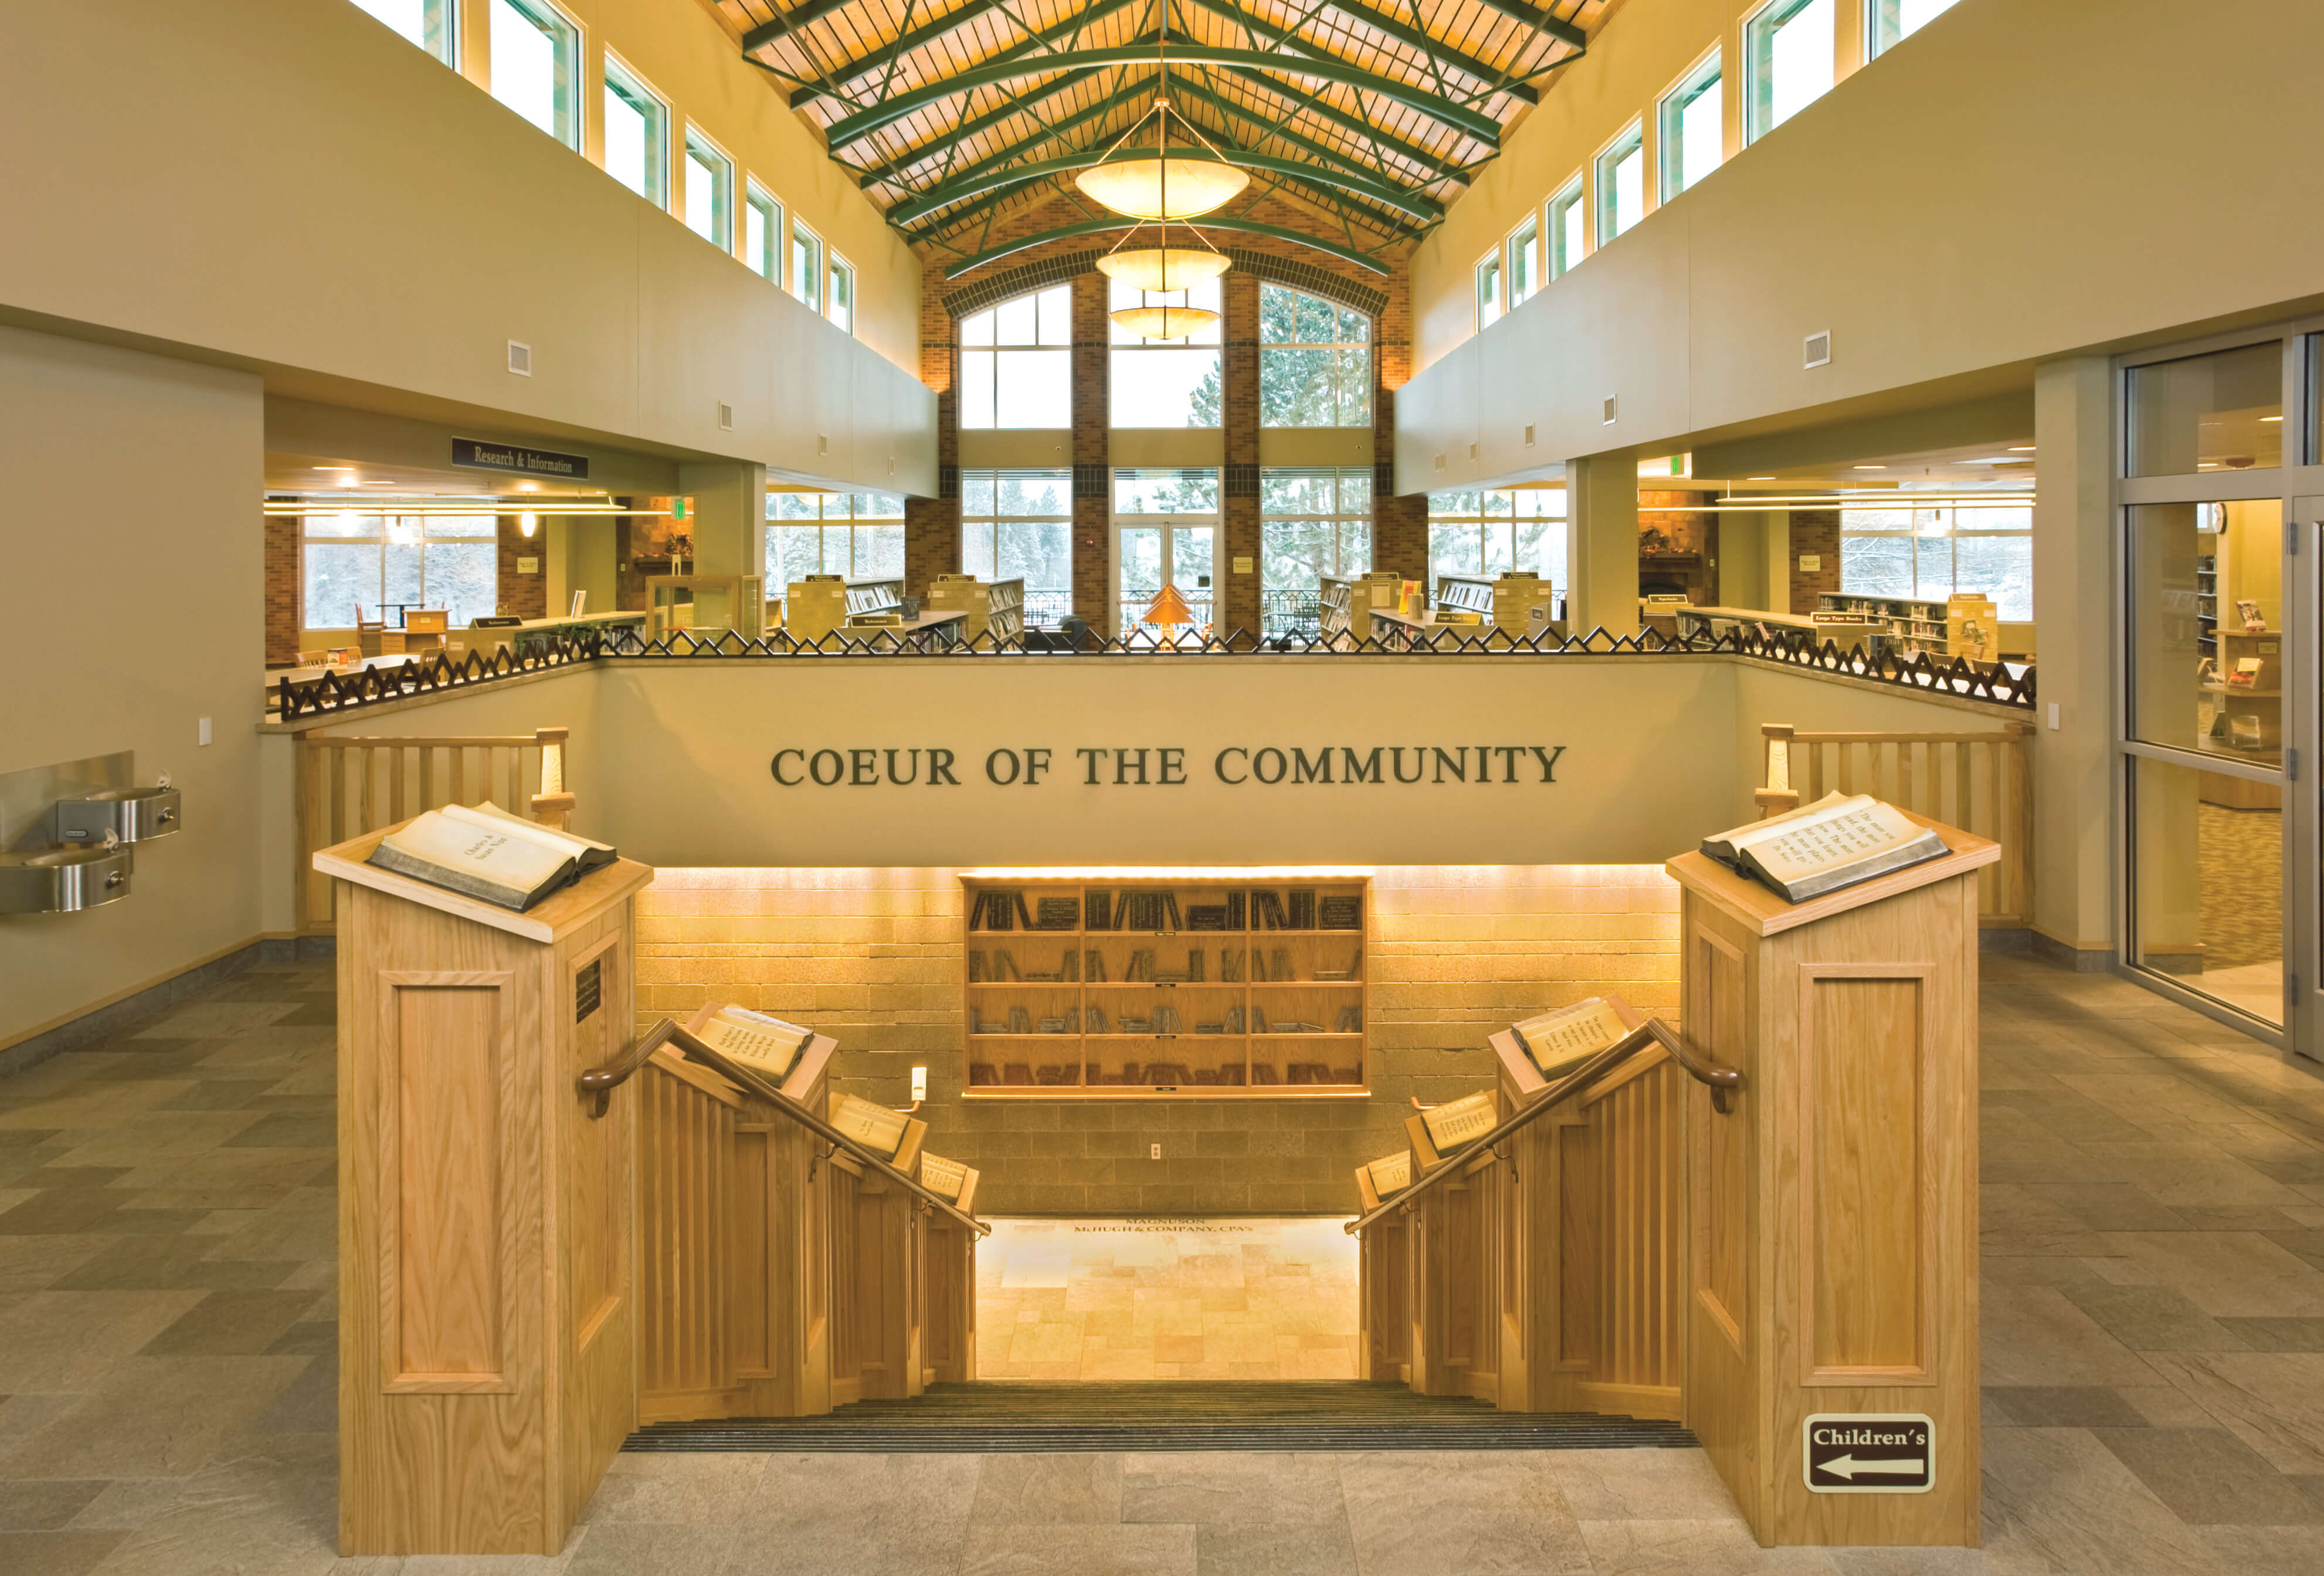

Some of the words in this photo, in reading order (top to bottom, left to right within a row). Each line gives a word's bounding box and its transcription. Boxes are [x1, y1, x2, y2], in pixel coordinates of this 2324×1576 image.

[474, 446, 514, 466] Research
[517, 452, 524, 467] &
[527, 453, 572, 473] Information
[771, 748, 962, 786] COEUR
[986, 748, 1052, 785] OF
[1076, 748, 1188, 785] THE
[1214, 746, 1567, 784] COMMUNITY
[1860, 813, 1871, 821] The
[1814, 1429, 1926, 1445] Children's
